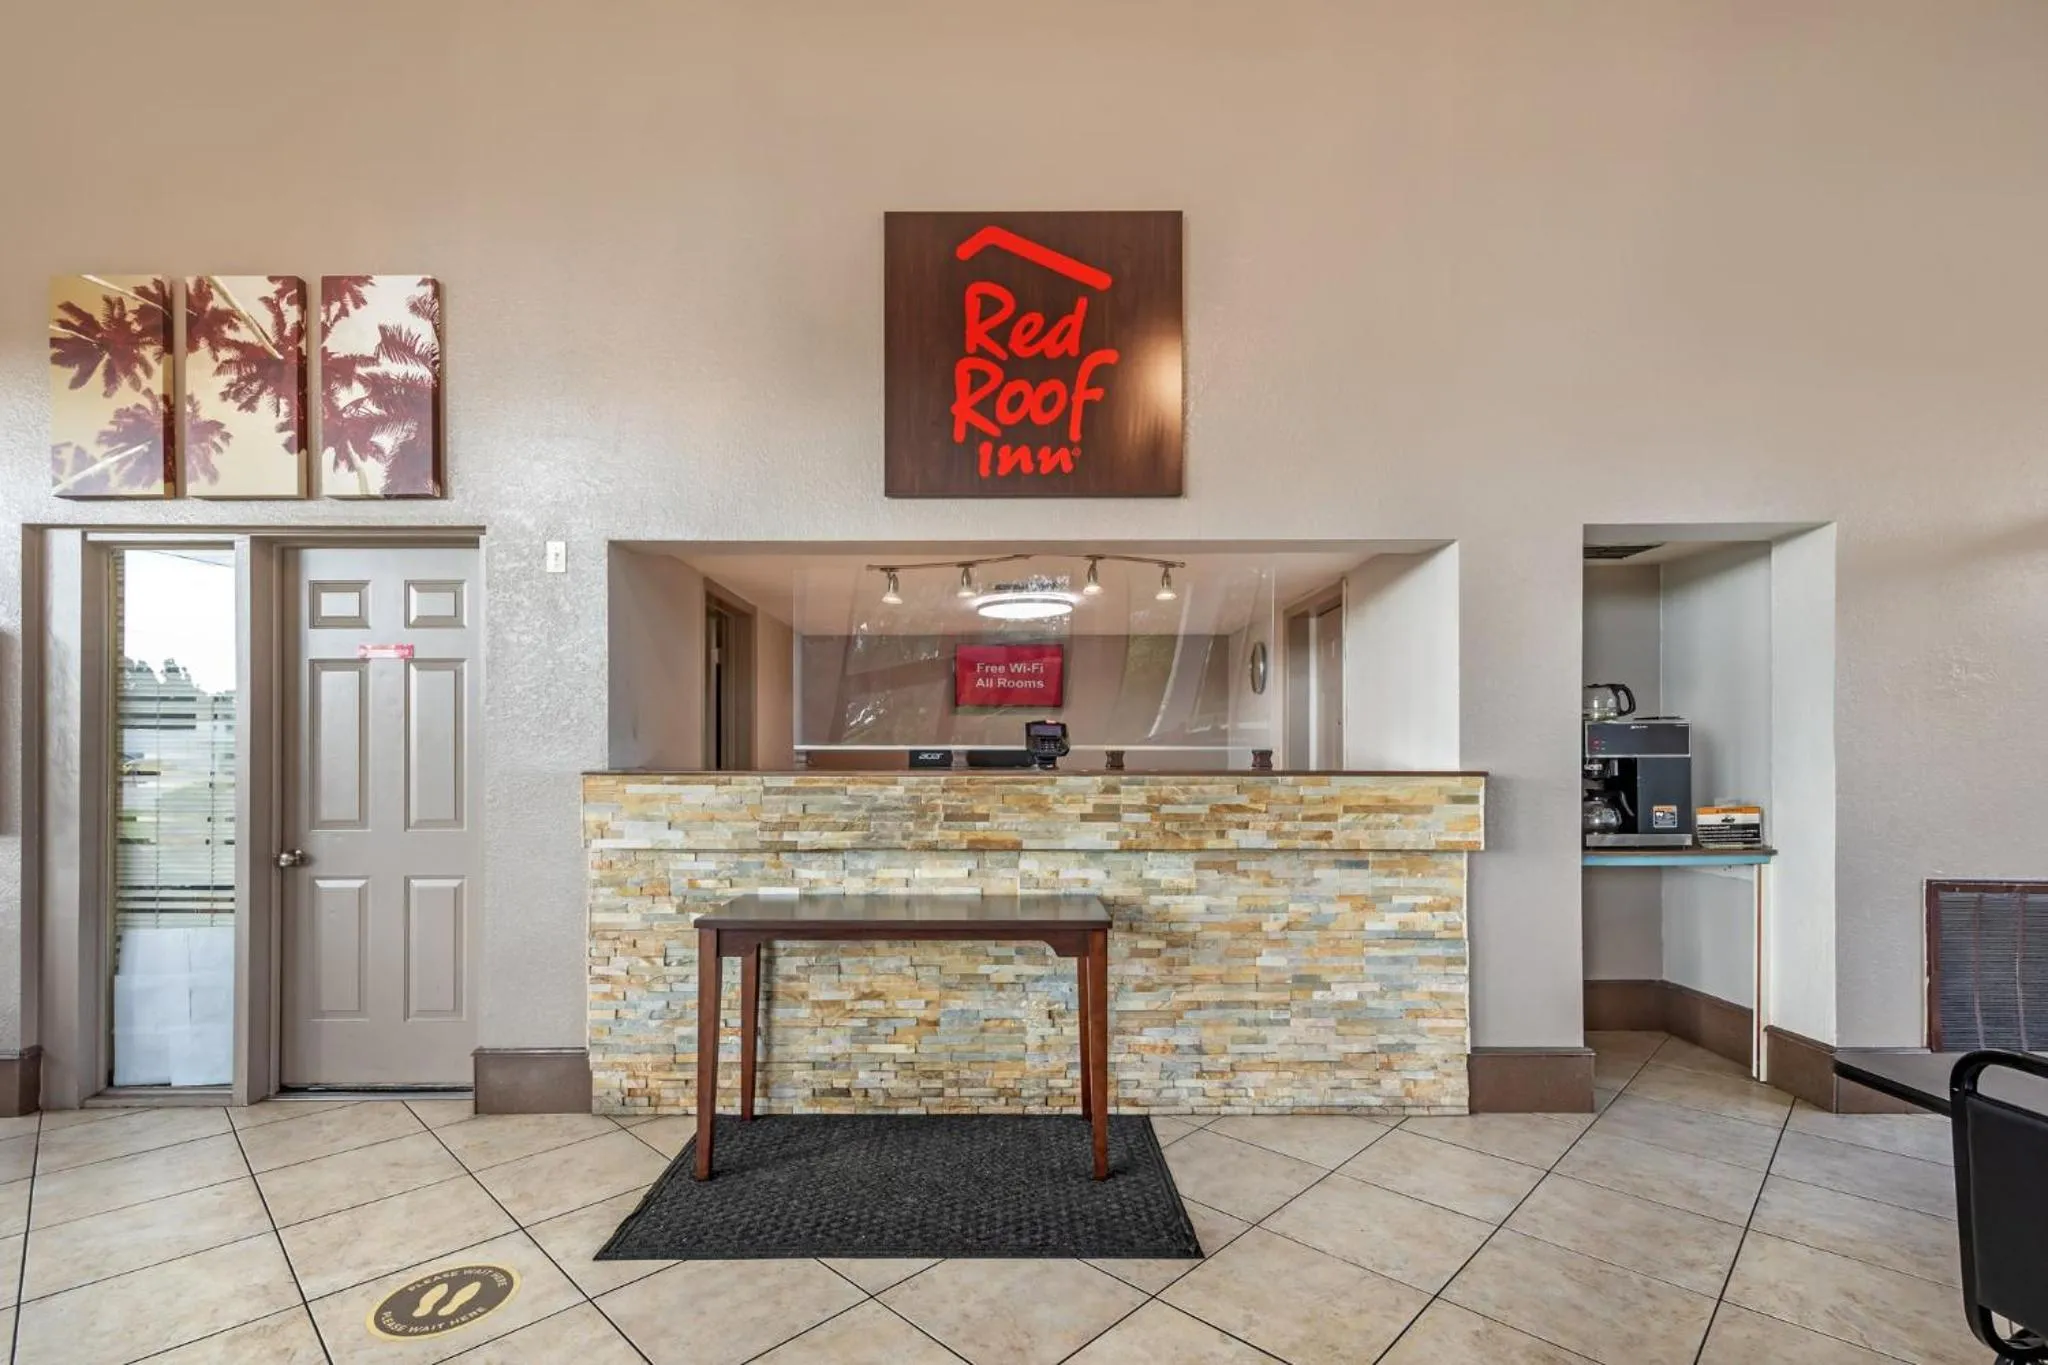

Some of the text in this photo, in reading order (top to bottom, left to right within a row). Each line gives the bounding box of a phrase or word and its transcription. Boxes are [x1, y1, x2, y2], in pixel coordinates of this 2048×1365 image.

[964, 281, 1088, 361] Red
[951, 349, 1119, 443] Roof
[976, 662, 1044, 674] Free Wi-Fi
[975, 677, 1045, 689] All Rooms
[918, 752, 944, 761] acer
[408, 1271, 459, 1292] PLEASE
[381, 1306, 487, 1334] PLEASE WAIT HERE
